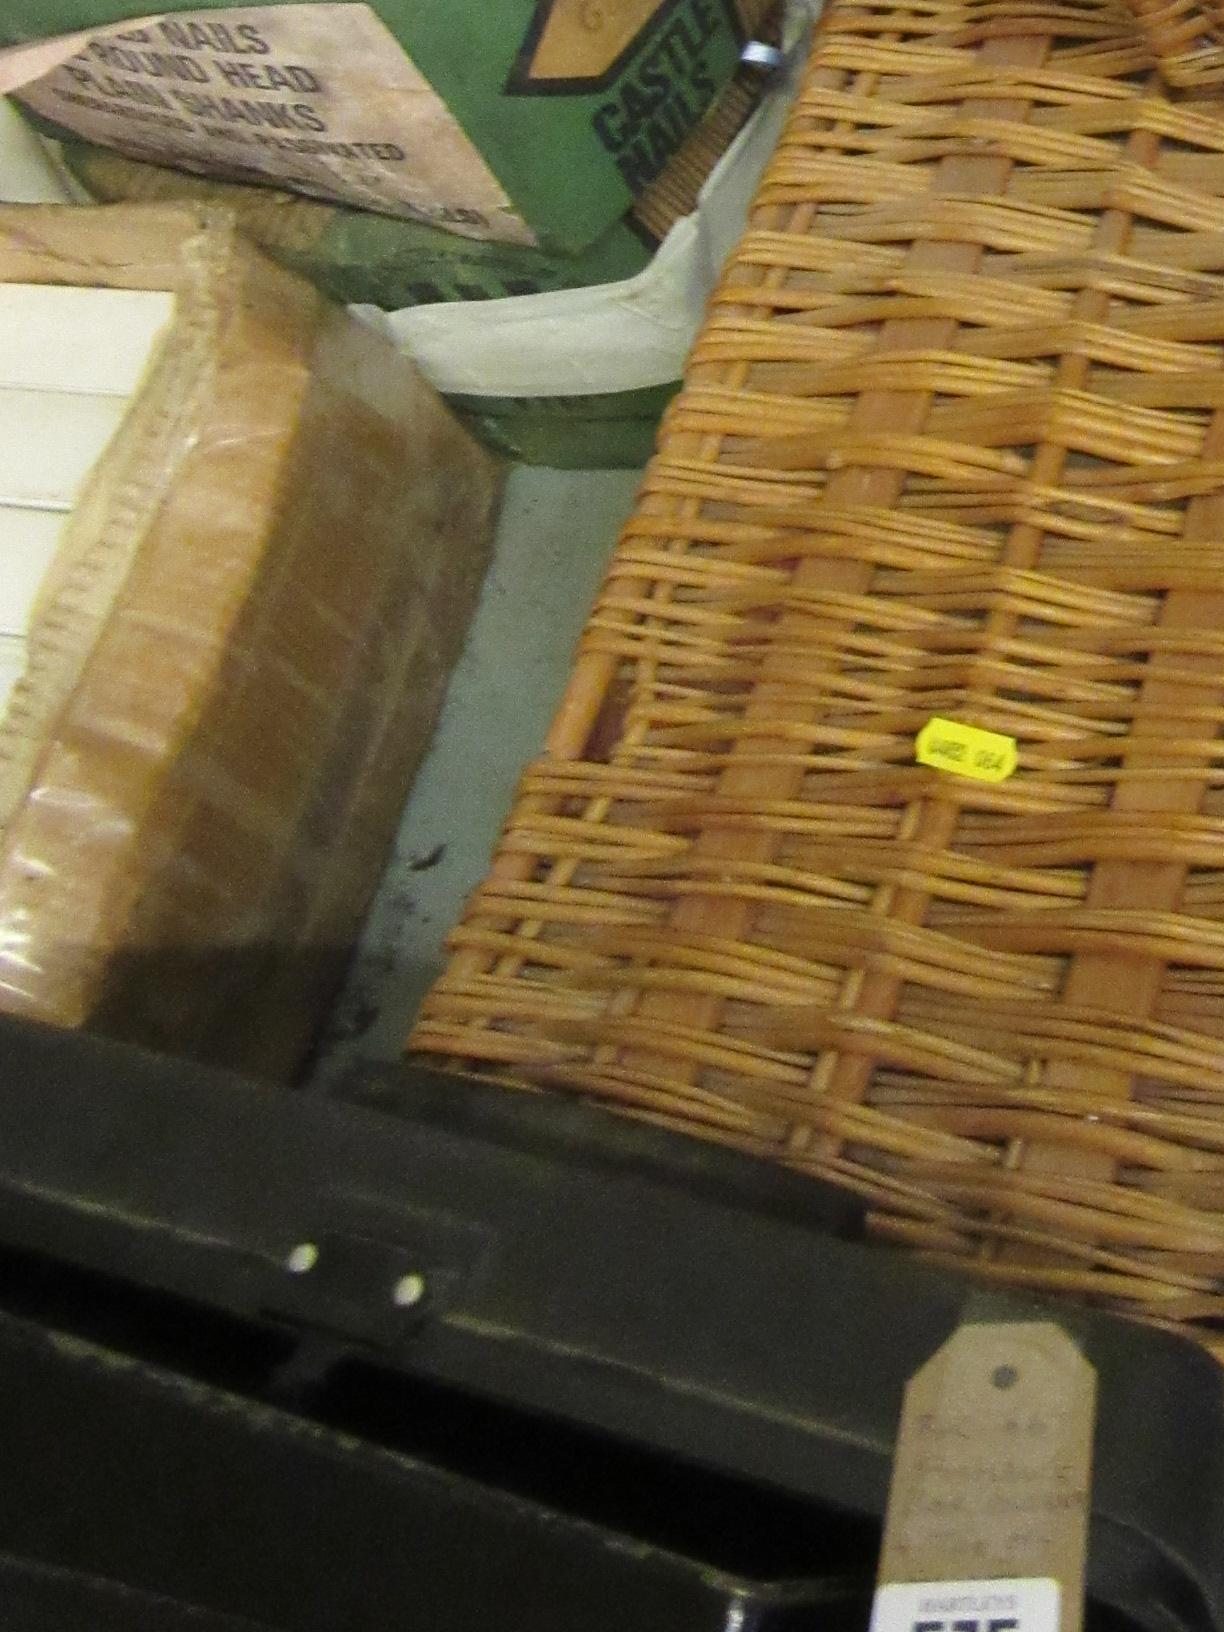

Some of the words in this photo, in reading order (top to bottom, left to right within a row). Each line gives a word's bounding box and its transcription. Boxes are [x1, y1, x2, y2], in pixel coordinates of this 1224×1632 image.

[157, 21, 271, 55] NAILS
[212, 59, 323, 93] HEAD
[168, 89, 327, 133] SHANKS
